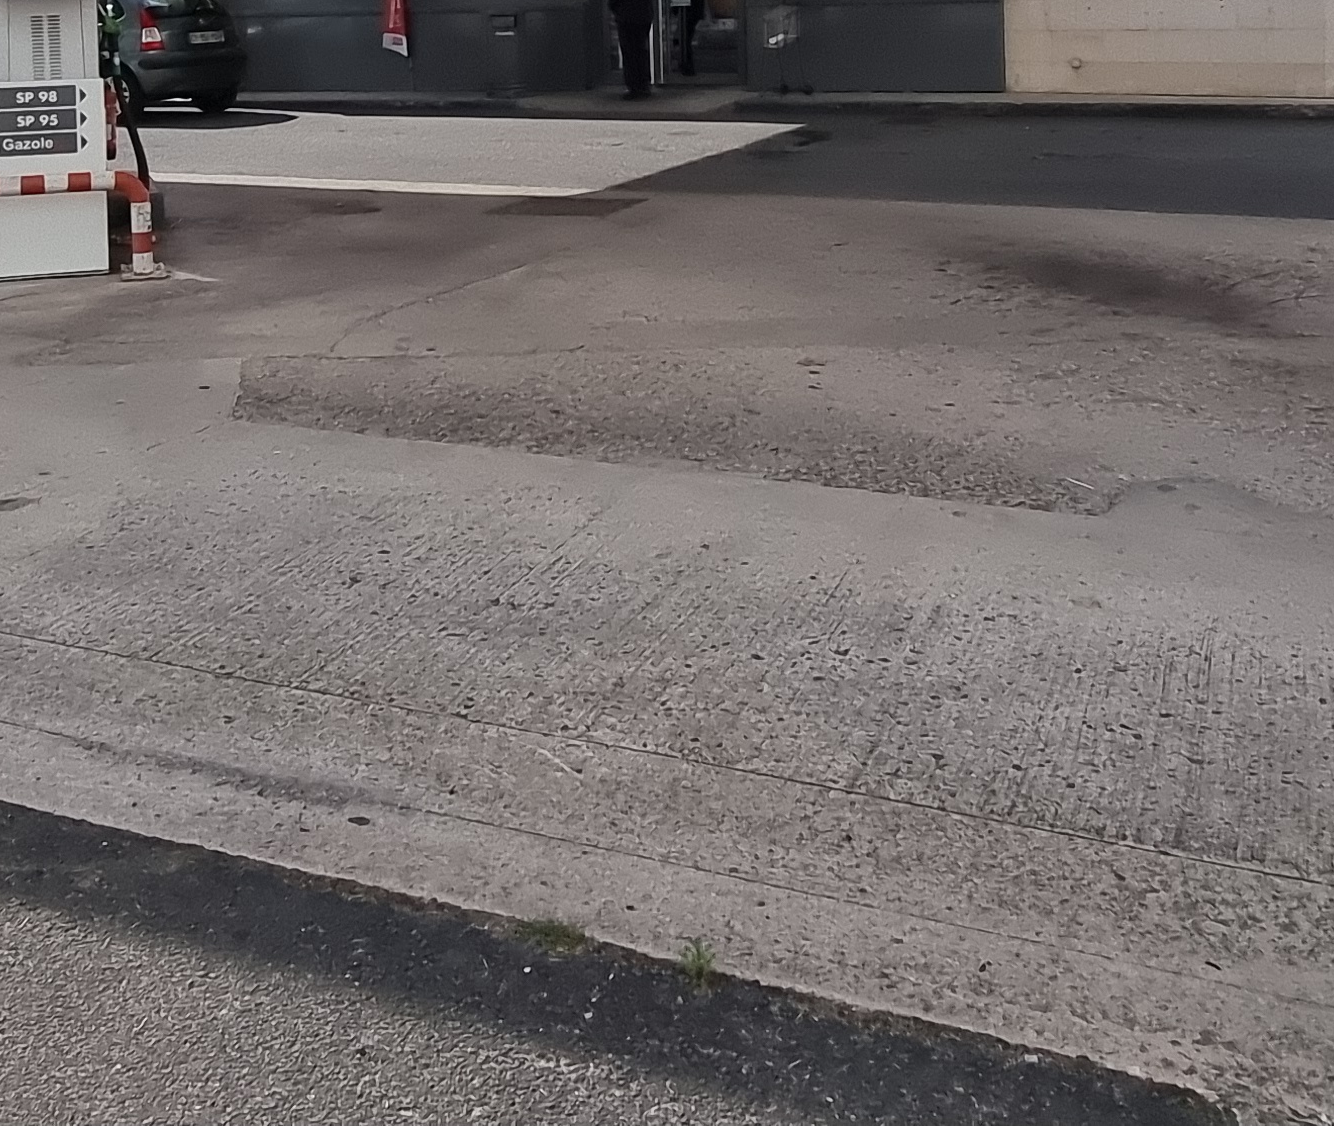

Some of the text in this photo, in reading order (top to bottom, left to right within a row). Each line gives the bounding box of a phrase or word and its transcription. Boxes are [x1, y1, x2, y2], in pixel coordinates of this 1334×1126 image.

[15, 90, 58, 104] SP 98
[16, 114, 59, 127] SP 95
[2, 137, 54, 151] Gazole
